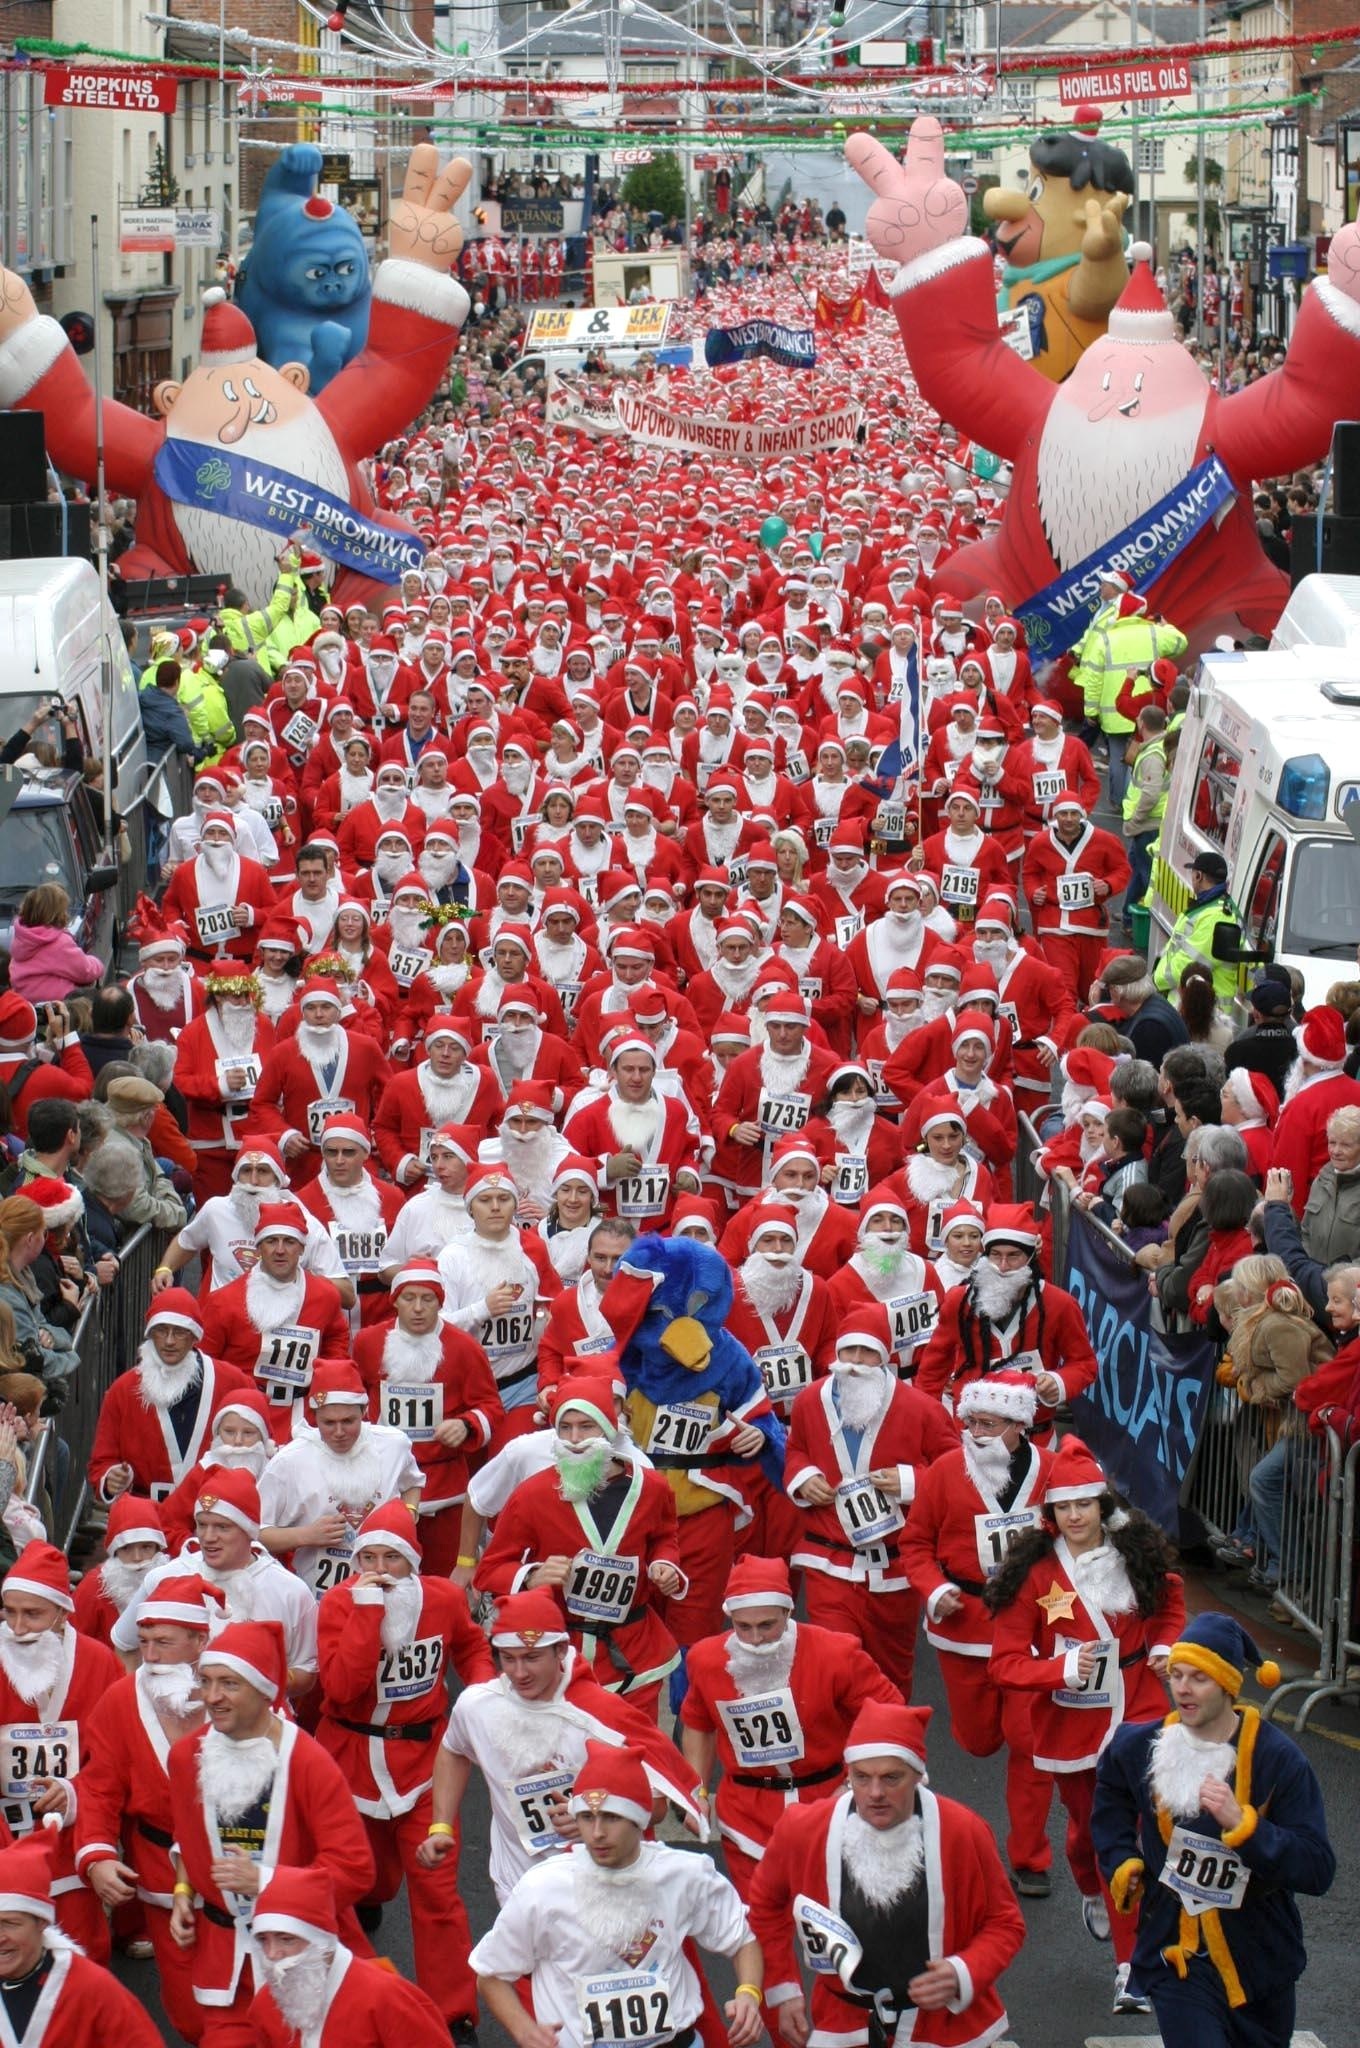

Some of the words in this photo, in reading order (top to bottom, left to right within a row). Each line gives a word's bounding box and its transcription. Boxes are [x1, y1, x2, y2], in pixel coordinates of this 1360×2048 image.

[70, 74, 153, 95] HOPKINS
[267, 91, 295, 101] SHOP
[1062, 74, 1122, 99] HOWELLS
[1124, 70, 1157, 94] FUEL
[1159, 67, 1188, 90] OILS
[62, 88, 119, 106] STEEL
[125, 92, 160, 109] LTD
[176, 221, 213, 230] HALIFAX
[503, 209, 563, 228] EXCHANGE
[537, 311, 571, 329] J.F.K.
[587, 310, 610, 334] &
[630, 306, 663, 325] J.F.K.
[728, 323, 758, 348] WEST
[678, 419, 740, 451] NURSERY
[745, 430, 754, 453] &
[759, 425, 806, 453] INFANT
[811, 413, 859, 445] SCHOOL
[245, 471, 313, 514] WEST
[1047, 564, 1104, 617] WEST
[1108, 460, 1223, 573] BROMWICH
[288, 717, 314, 745] 1258
[1036, 778, 1066, 797] 1200
[943, 874, 977, 896] 2195
[1062, 882, 1090, 902] 975
[391, 953, 424, 978] 357
[763, 1101, 808, 1130] 1735
[619, 1178, 668, 1204] 1217
[481, 1315, 532, 1346] 2062
[895, 1302, 932, 1338] 408
[270, 1338, 312, 1371] 119
[388, 1398, 434, 1428] 811
[670, 1405, 709, 1419] DIAL-A-RIDE
[845, 1488, 893, 1528] 104
[988, 1514, 1031, 1527] DIAL-A-RIDE
[588, 1555, 631, 1570] DIAL-A-RIDE
[570, 1566, 637, 1606] 1996
[380, 1641, 442, 1683] 2532
[730, 1697, 781, 1714] DIAL-A-RIDE
[732, 1711, 793, 1749] 529
[11, 1744, 67, 1780] 343
[518, 1776, 570, 1794] DIAL-A-RIDE
[1177, 1848, 1240, 1890] 806
[591, 1976, 651, 1991] DIAL-A-RIDE
[585, 1991, 673, 2041] 1192
